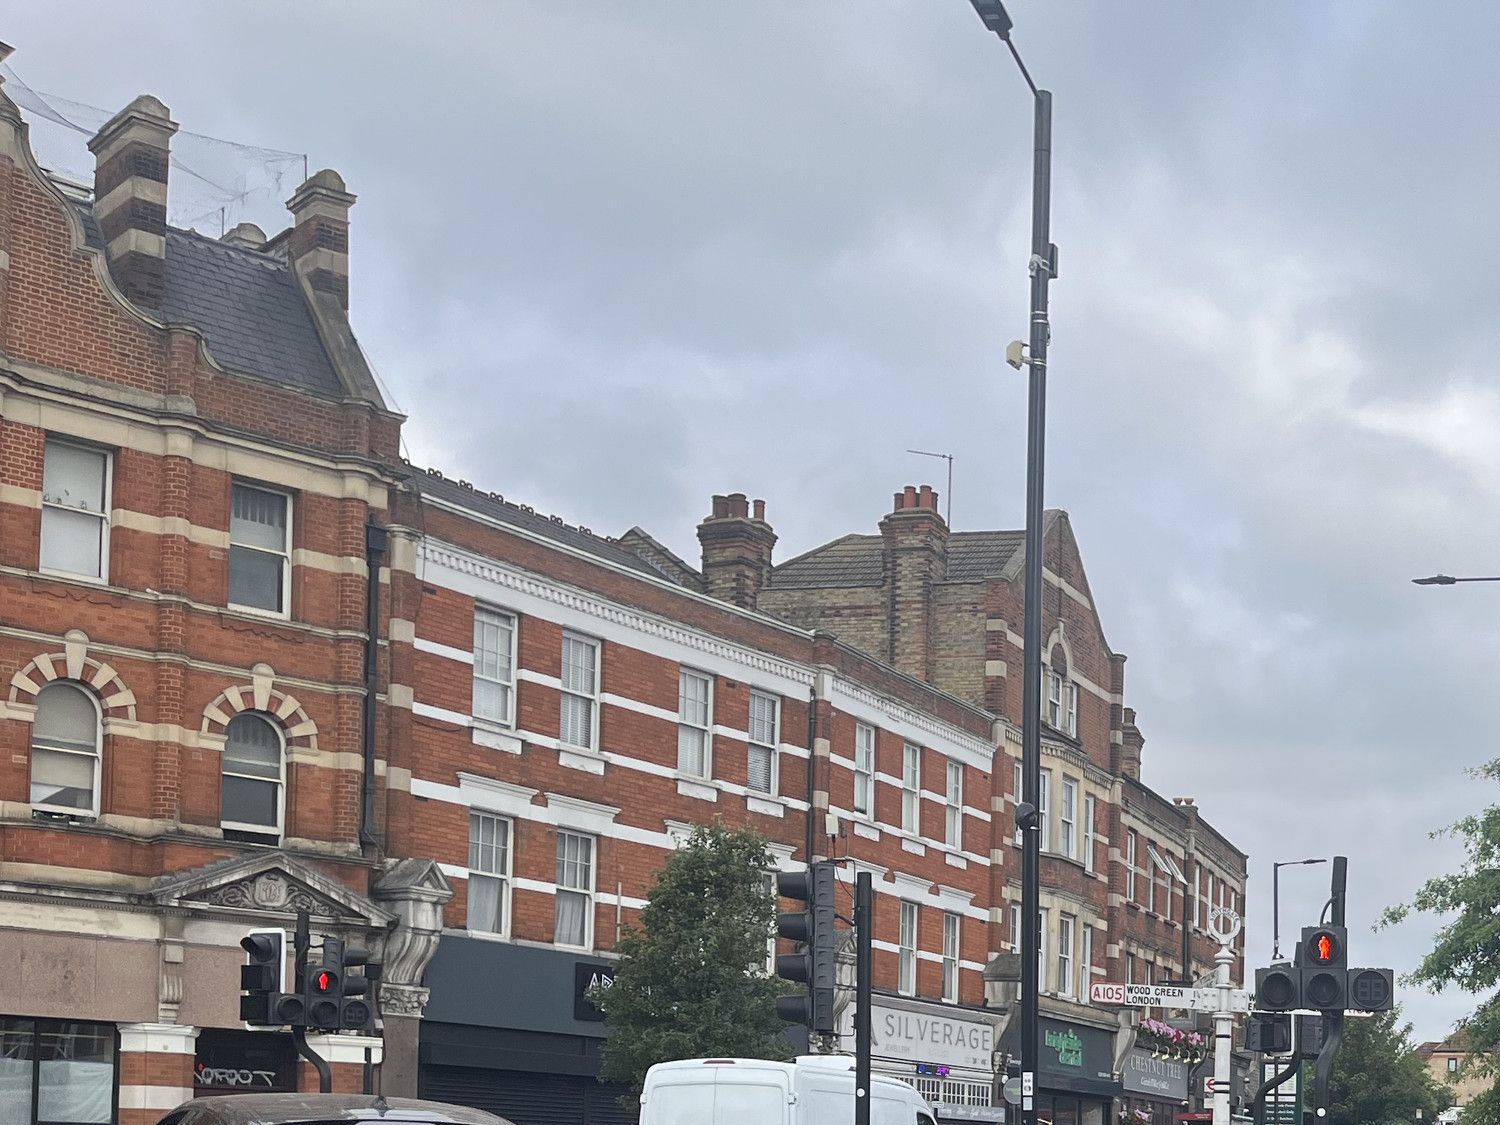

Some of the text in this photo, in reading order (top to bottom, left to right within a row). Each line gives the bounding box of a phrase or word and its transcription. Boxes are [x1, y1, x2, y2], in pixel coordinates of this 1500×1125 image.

[1093, 987, 1123, 1000] A105
[1127, 986, 1150, 995] WOOD
[1155, 987, 1183, 997] GREEN
[1126, 995, 1161, 1005] LONDON
[885, 1014, 991, 1051] SILVERAGE
[1131, 1055, 1181, 1079] CHESTNUT TREE
